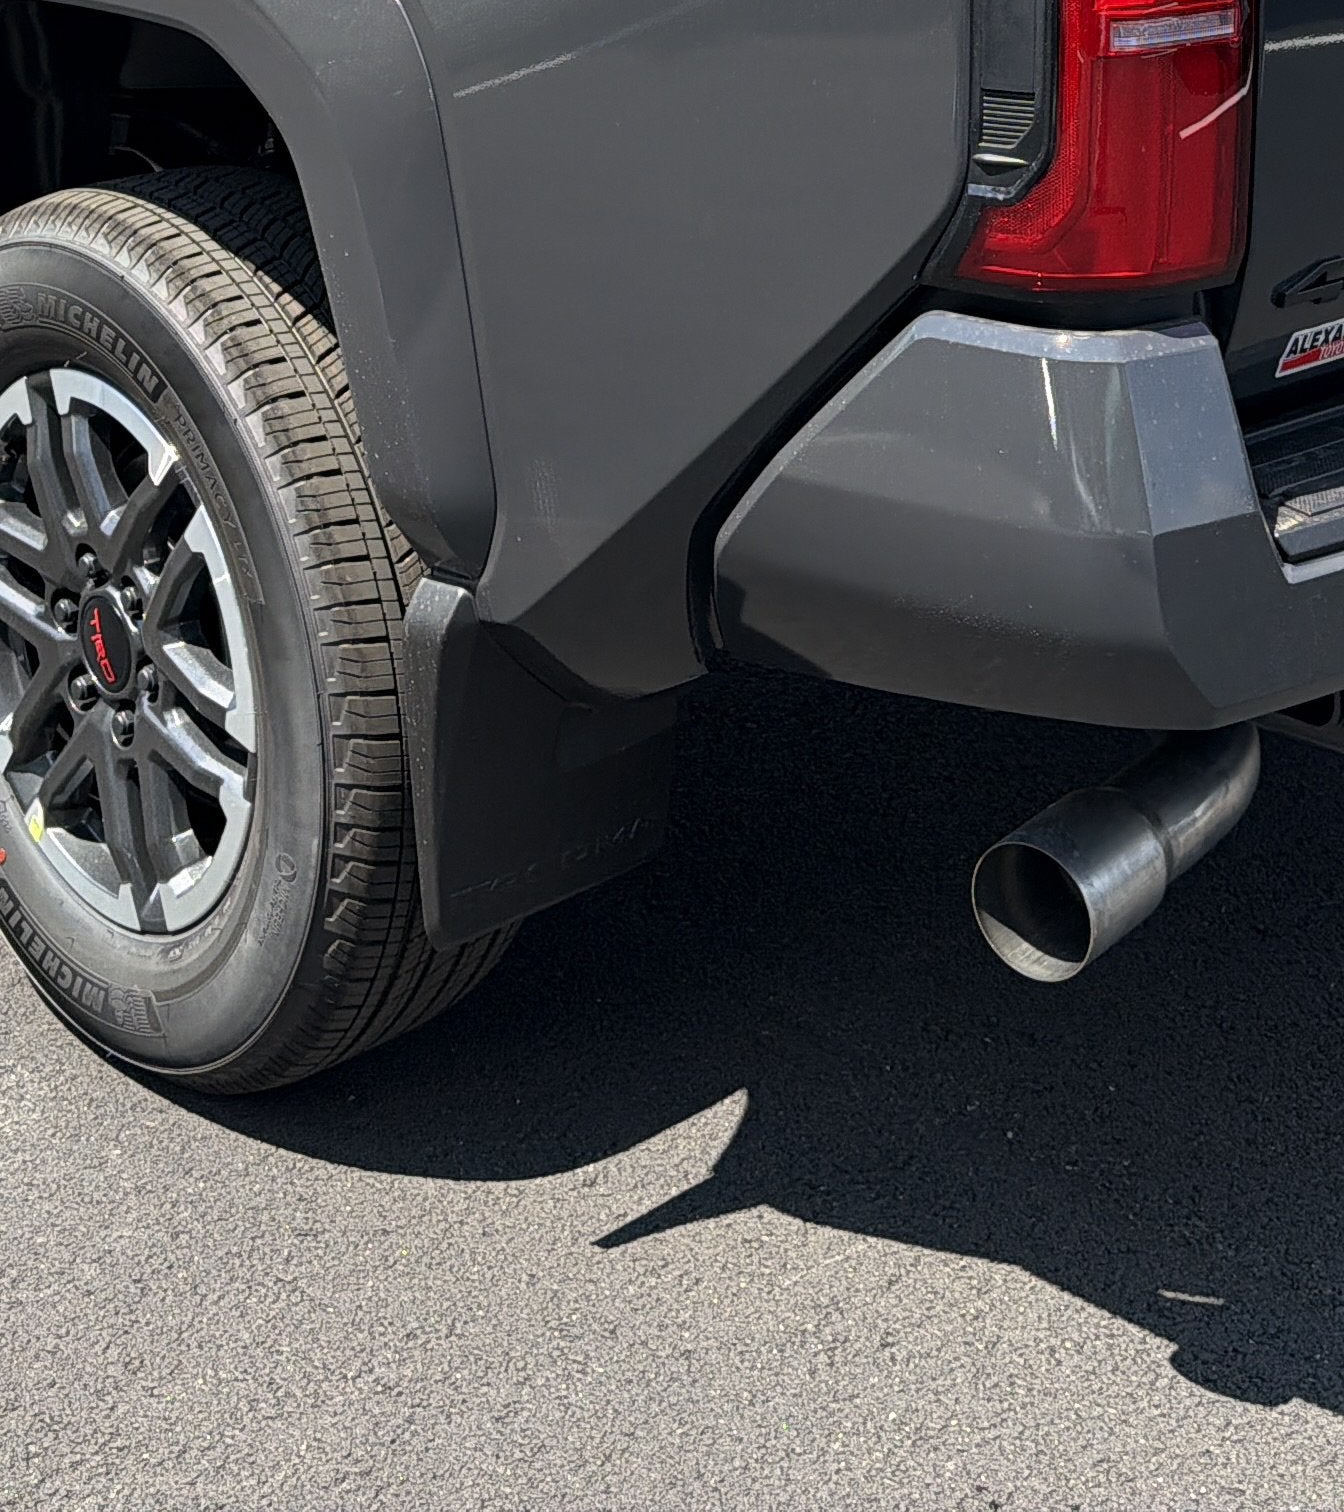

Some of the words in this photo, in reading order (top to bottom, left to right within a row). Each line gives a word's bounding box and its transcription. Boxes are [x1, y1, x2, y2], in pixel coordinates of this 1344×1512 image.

[36, 292, 160, 394] MICHELIN
[176, 414, 237, 528] PRIMACY
[90, 607, 117, 683] TRD
